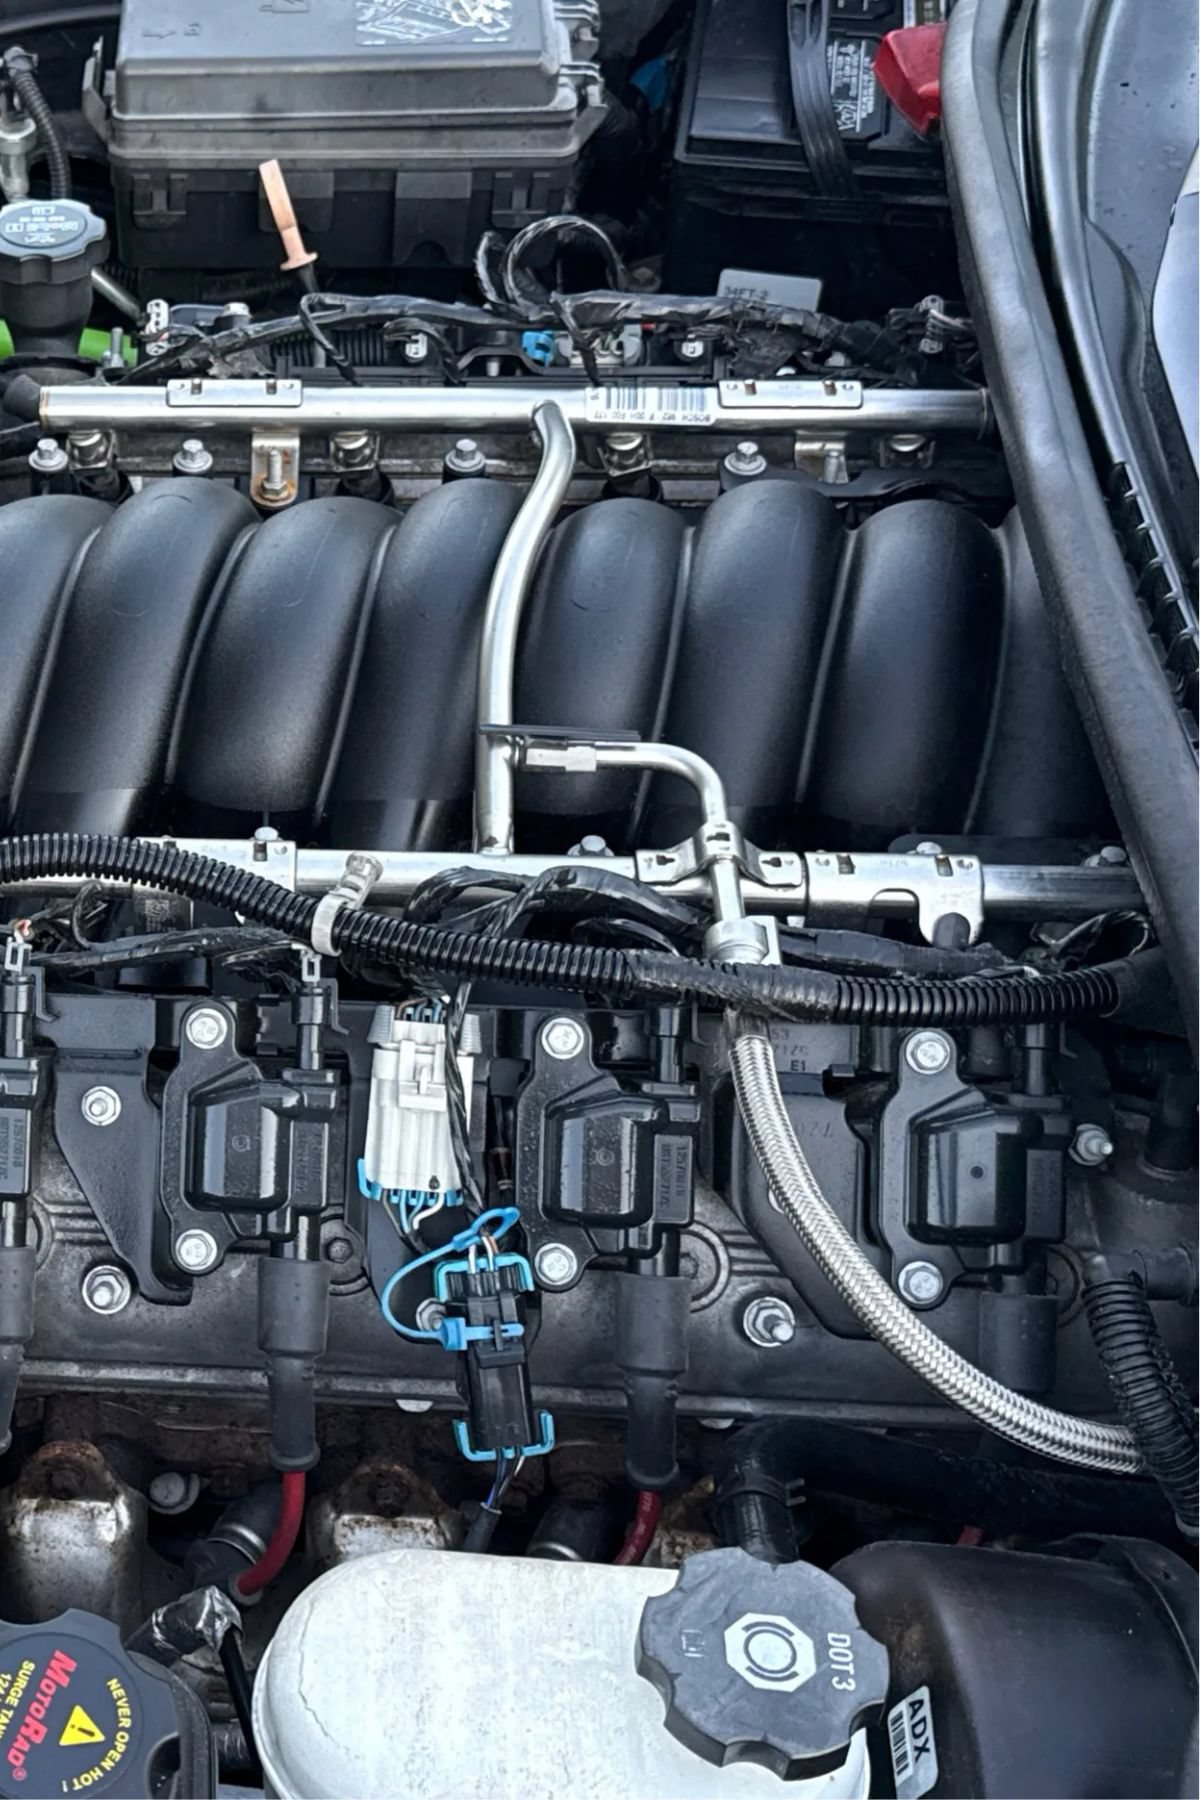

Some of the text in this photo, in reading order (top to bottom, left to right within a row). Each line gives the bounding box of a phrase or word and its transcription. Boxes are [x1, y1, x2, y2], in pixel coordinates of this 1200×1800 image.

[790, 1059, 806, 1072] E1
[5, 1660, 36, 1707] SURGE
[827, 1632, 856, 1691] DOT 3
[106, 1678, 133, 1729] NEVER
[100, 1731, 130, 1771] OPEN
[908, 1698, 931, 1763] ADX
[72, 1767, 104, 1791] HOT
